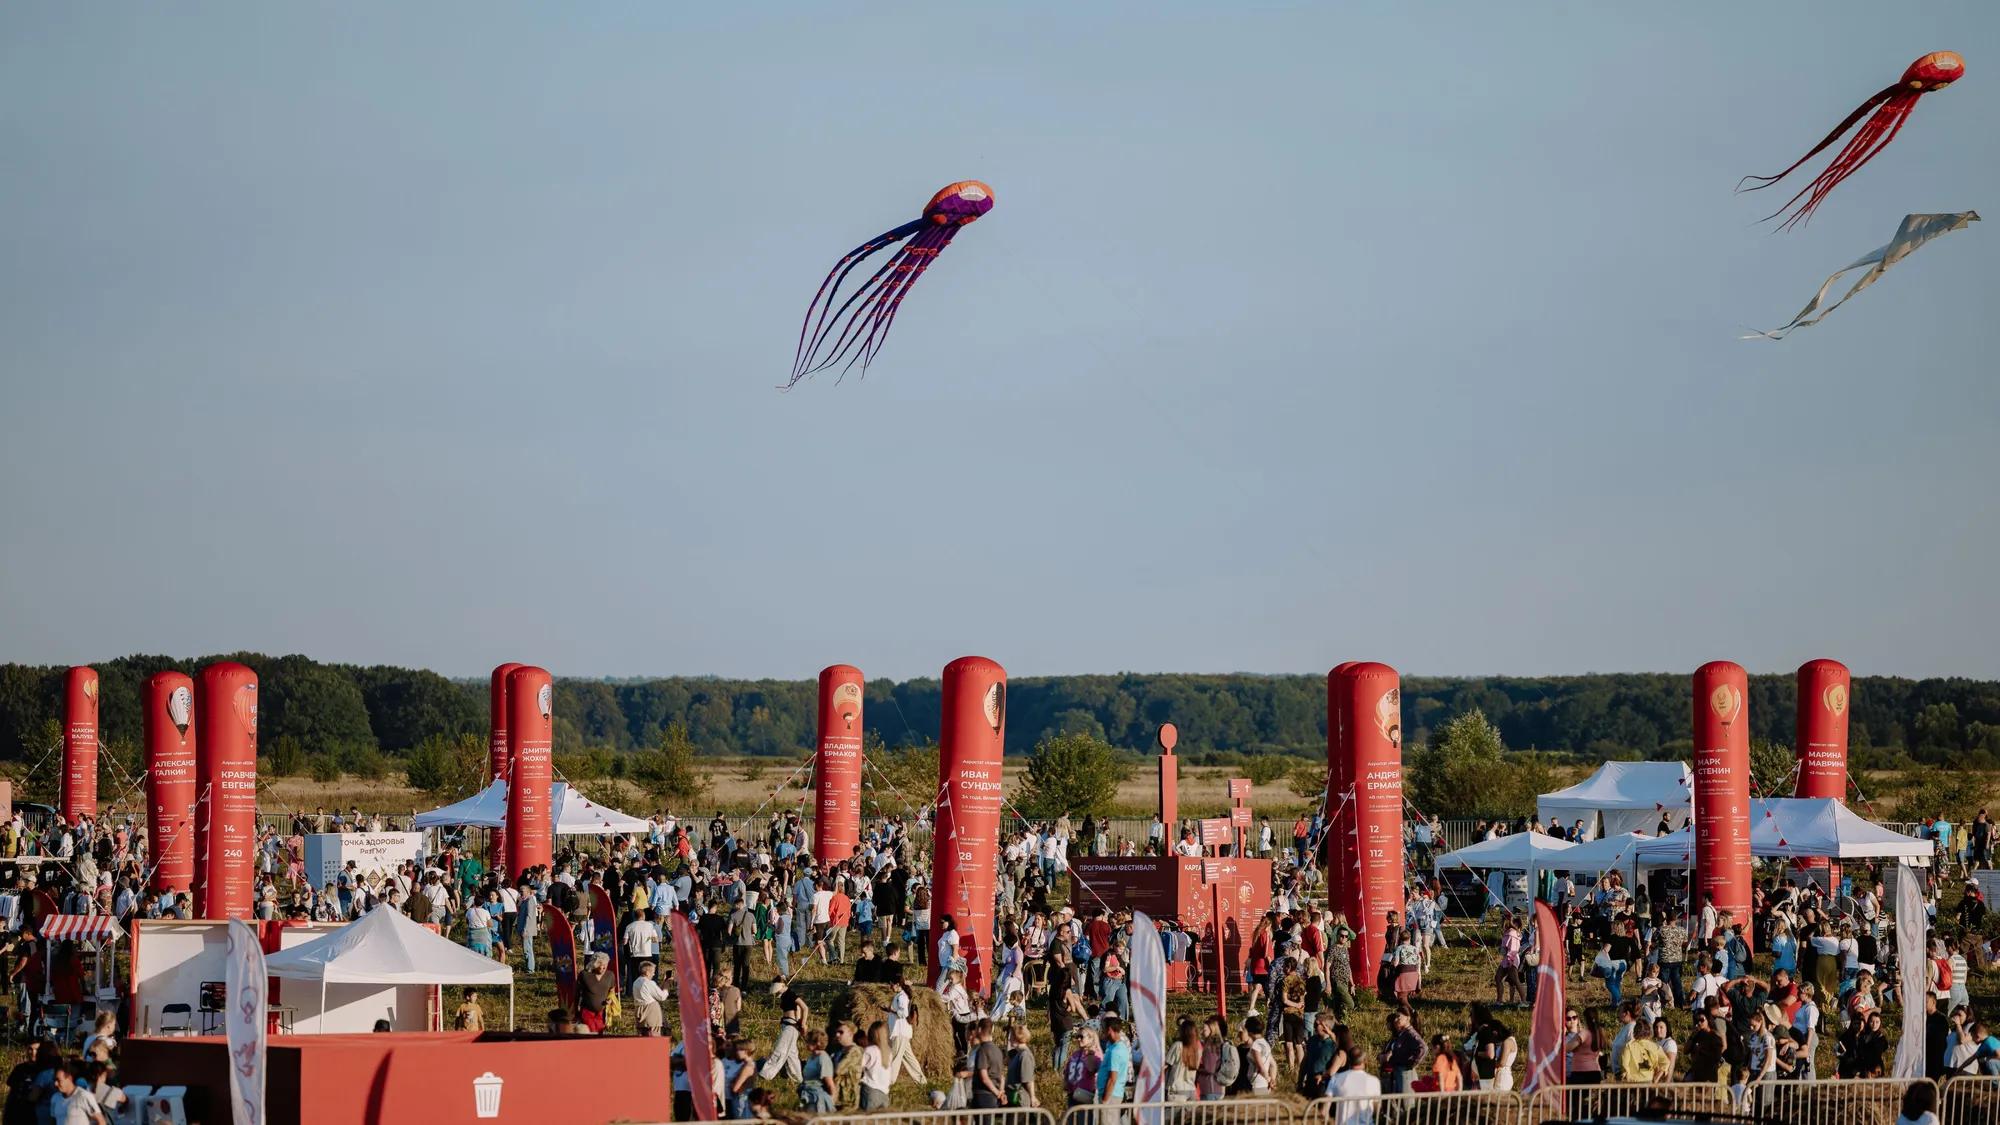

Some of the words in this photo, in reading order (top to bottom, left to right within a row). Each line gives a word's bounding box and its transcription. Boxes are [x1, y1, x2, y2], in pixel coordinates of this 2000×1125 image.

[824, 750, 857, 758] ЕРМАКОВ
[1808, 751, 1842, 759] МАРИНА
[1697, 758, 1721, 766] МАРК
[1808, 760, 1845, 768] МАВРИНА
[155, 768, 187, 777] ГАЛКИН
[961, 770, 989, 779] ИВАН
[1698, 767, 1731, 775] СТЕНИН
[823, 799, 837, 807] 525
[158, 805, 164, 813] 9
[1700, 807, 1705, 815] 2
[1732, 806, 1738, 814] 8
[159, 825, 172, 833] 153
[224, 824, 236, 833] 14
[960, 826, 965, 835] 1
[1369, 825, 1380, 833] 12
[1733, 828, 1739, 836] 2
[340, 839, 365, 847] ТОЧКА
[365, 838, 405, 847] ЗДОРОВЬЯ
[224, 849, 243, 858] 240
[959, 852, 972, 861] 28
[1370, 849, 1384, 858] 112
[1079, 863, 1118, 871] ПРОГРАММА
[1118, 863, 1157, 871] ФЕСТИВАЛЯ
[1068, 1061, 1084, 1081] 53
